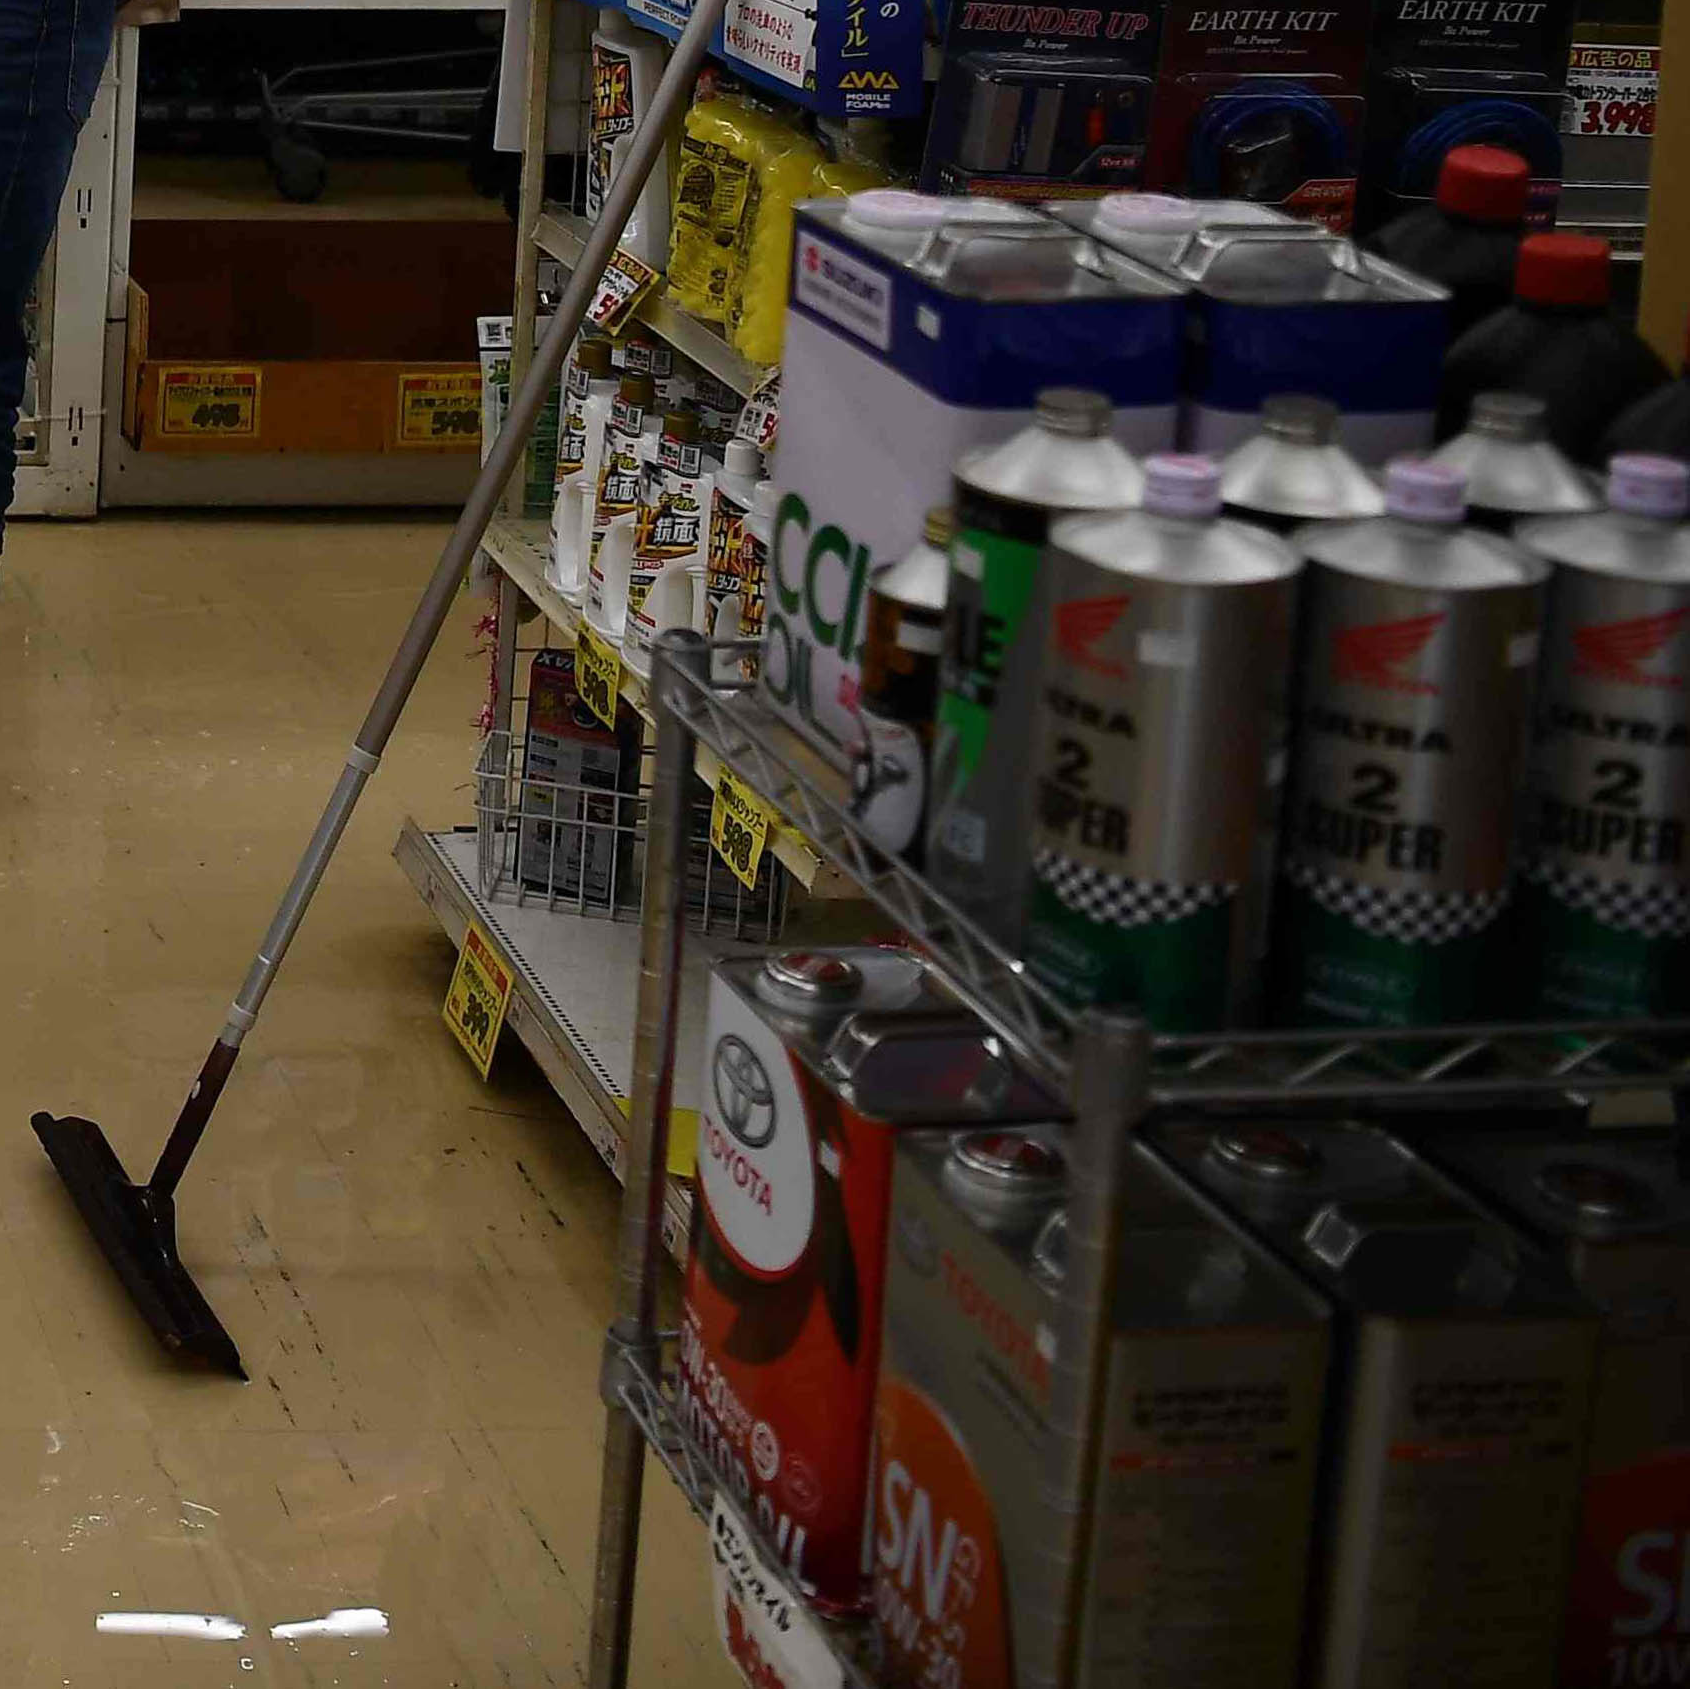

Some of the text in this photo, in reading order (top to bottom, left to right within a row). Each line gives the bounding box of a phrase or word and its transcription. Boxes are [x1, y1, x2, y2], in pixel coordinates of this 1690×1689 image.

[960, 1, 1149, 41] THUNDER UP
[1189, 9, 1338, 34] EARTH KIT
[1493, 0, 1546, 26] KIT
[1581, 49, 1653, 69] 広告の品
[845, 93, 892, 101] MOBILE
[1053, 740, 1092, 791] 2
[1351, 764, 1400, 812] 2
[1594, 760, 1642, 809] 2
